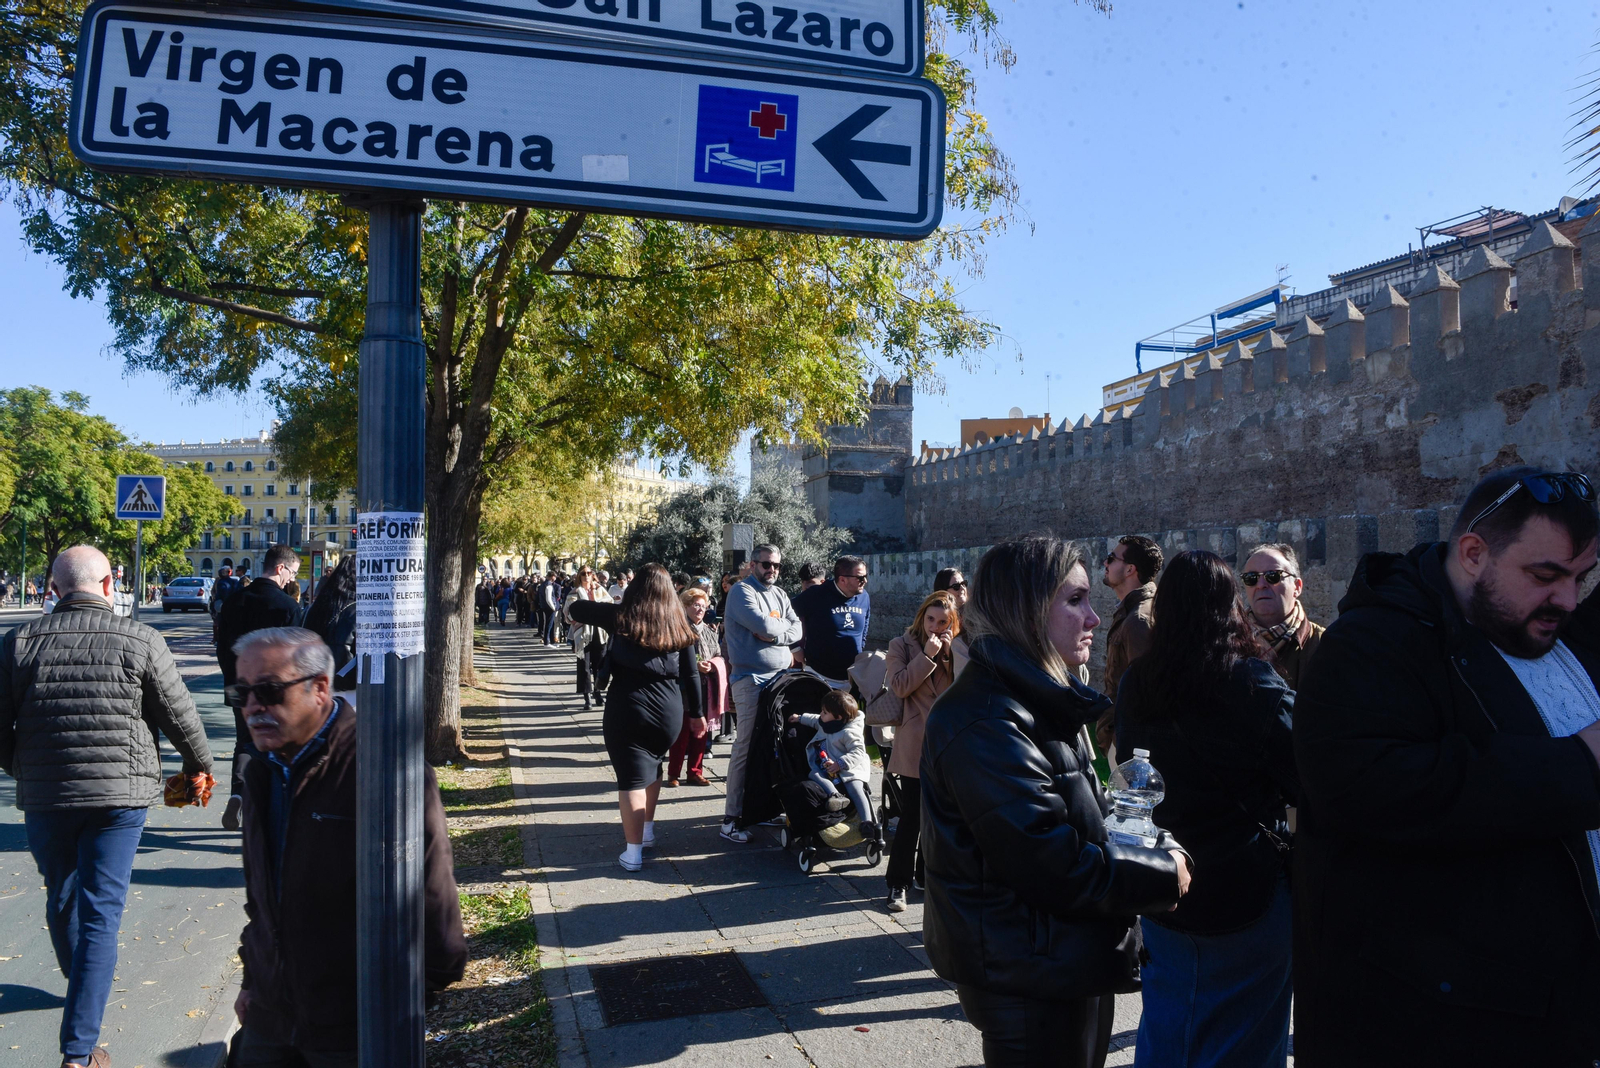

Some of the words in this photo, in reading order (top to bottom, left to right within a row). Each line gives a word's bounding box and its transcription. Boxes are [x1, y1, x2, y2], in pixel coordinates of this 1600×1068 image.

[701, 0, 895, 57] Lazaro
[122, 27, 344, 95] Virgen
[386, 56, 468, 105] de
[110, 87, 171, 141] la
[217, 98, 555, 173] Macarena
[360, 558, 424, 574] PINTURA
[390, 574, 410, 582] DESDE
